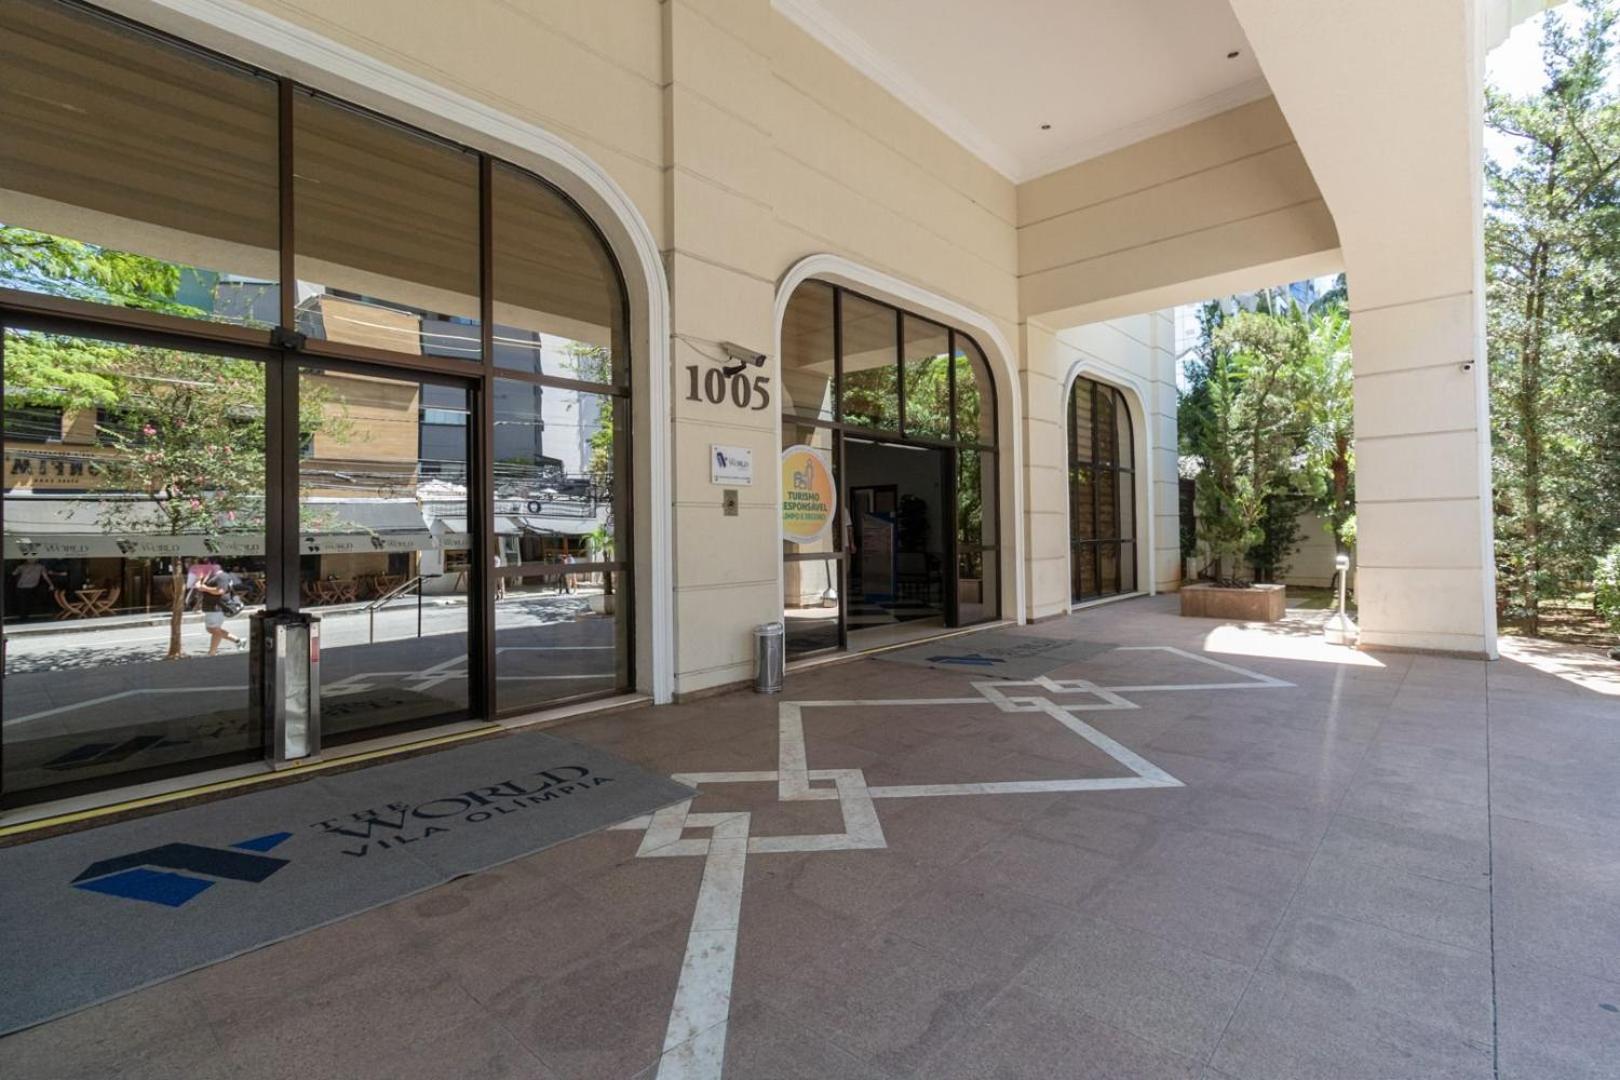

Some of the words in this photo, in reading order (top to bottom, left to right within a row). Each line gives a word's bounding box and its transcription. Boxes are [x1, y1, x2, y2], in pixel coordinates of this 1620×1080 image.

[686, 364, 770, 411] 1005
[783, 501, 828, 512] ESPONSÁVEL
[787, 491, 820, 501] TURISMO
[309, 801, 411, 830] THE
[324, 764, 590, 840] WORLD
[340, 824, 450, 858] VILA
[465, 776, 615, 824] OLIMPIA
